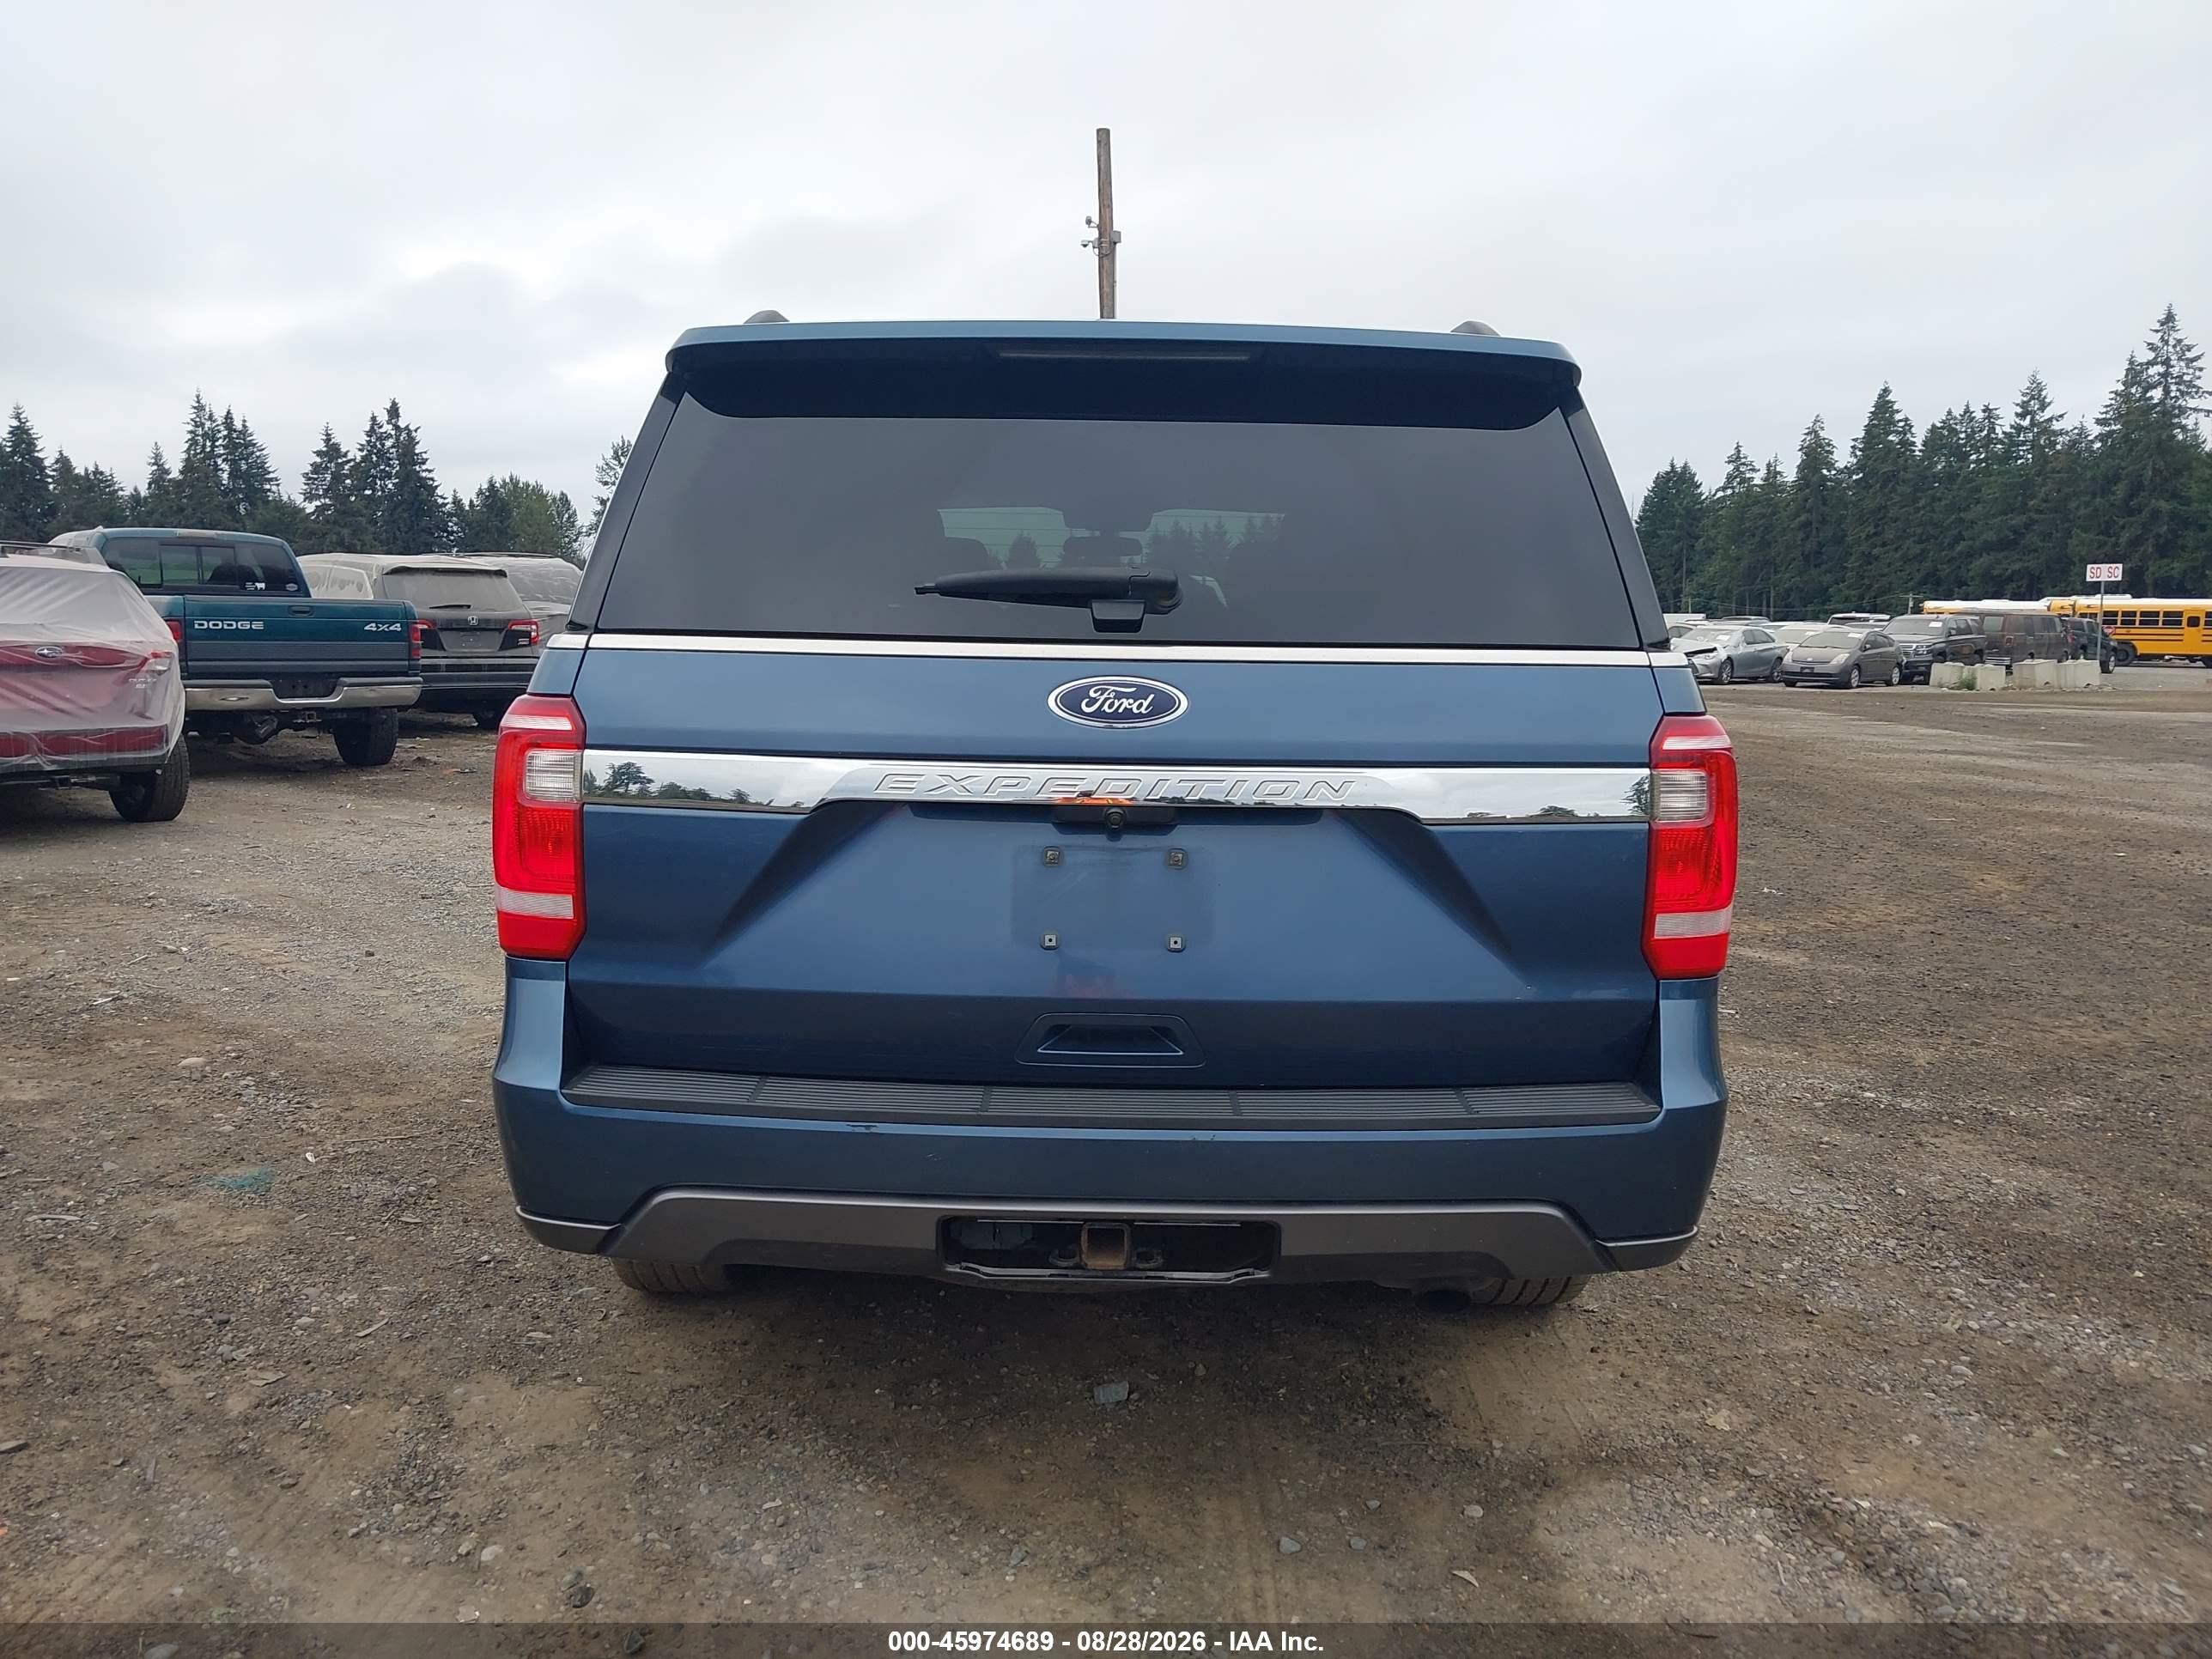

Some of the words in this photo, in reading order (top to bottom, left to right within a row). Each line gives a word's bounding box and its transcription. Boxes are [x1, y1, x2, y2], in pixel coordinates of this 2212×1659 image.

[2089, 566, 2102, 579] SD
[2107, 566, 2119, 578] SC
[194, 620, 264, 630] DODGE
[1080, 685, 1155, 714] Ford
[873, 773, 1356, 800] EXPEDITION
